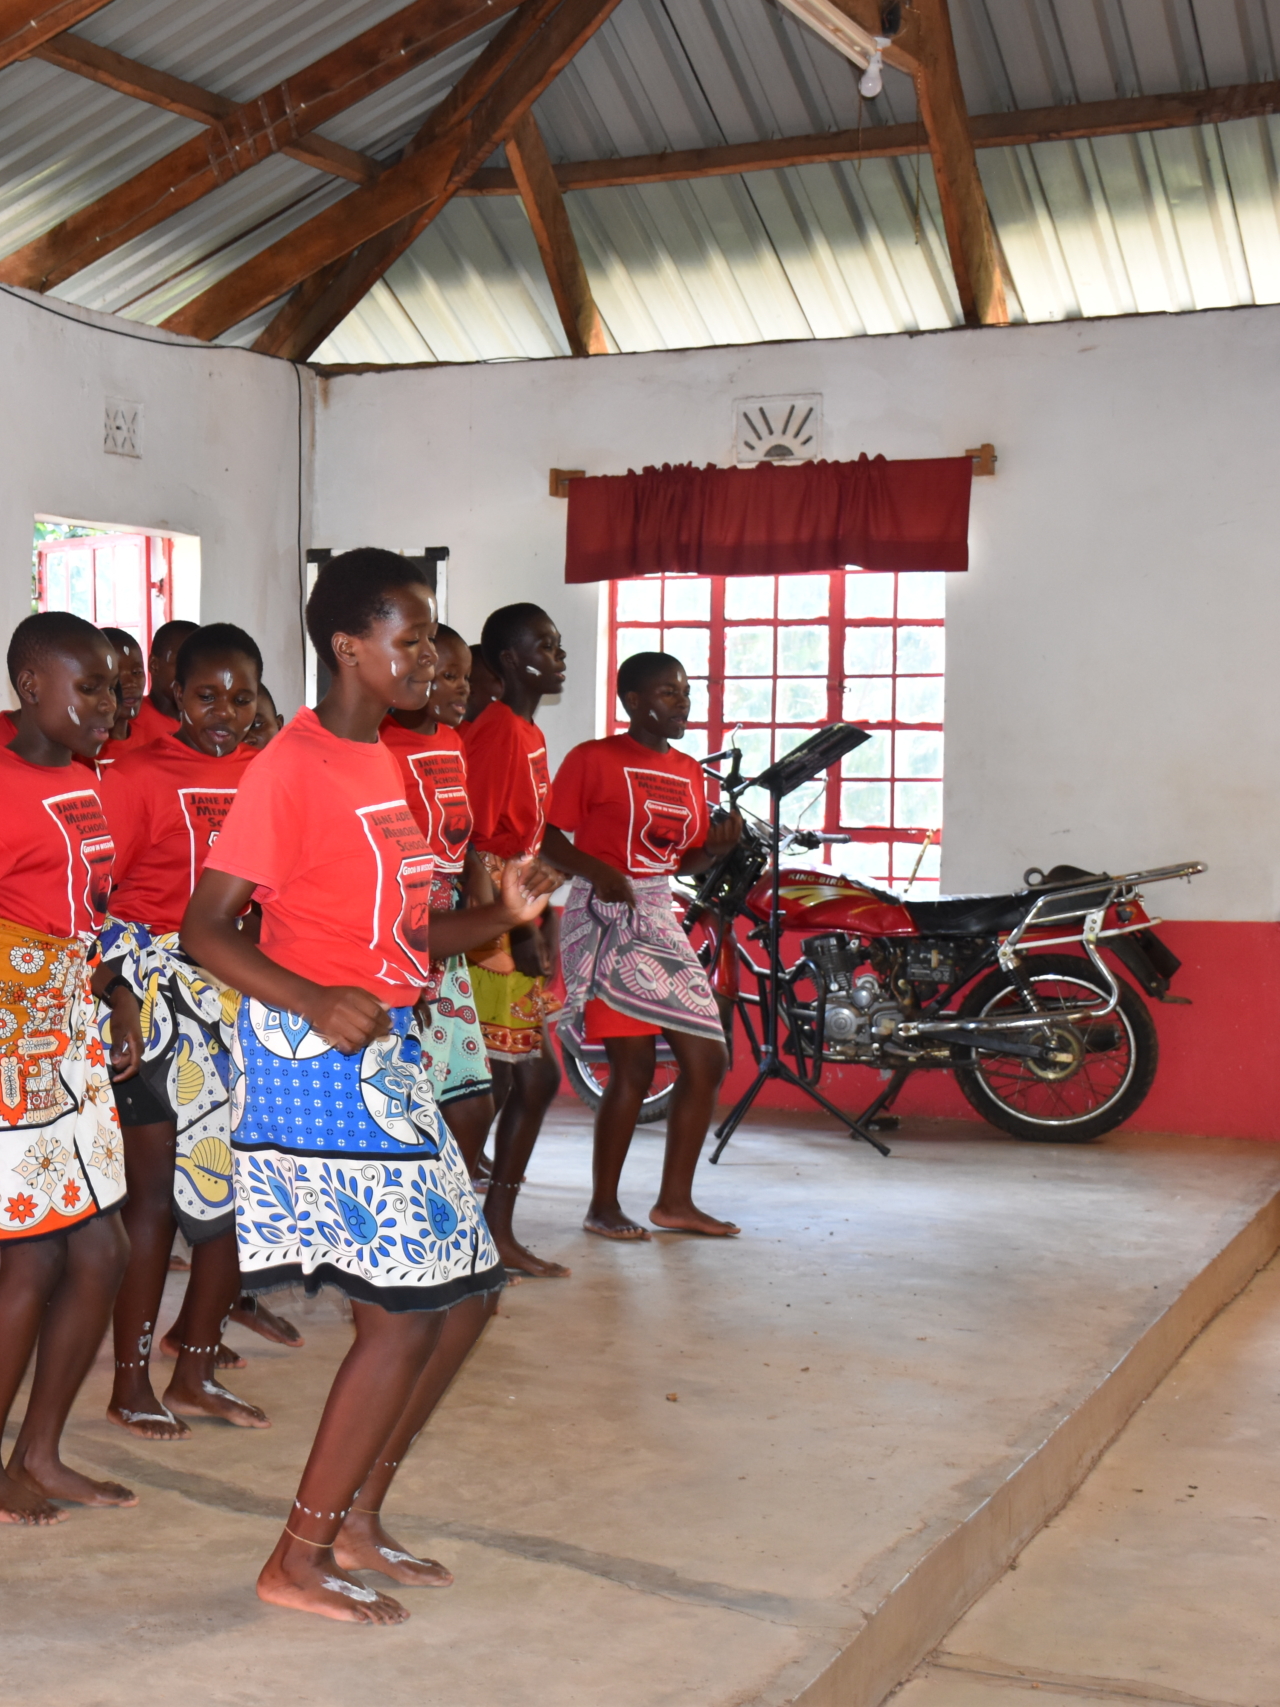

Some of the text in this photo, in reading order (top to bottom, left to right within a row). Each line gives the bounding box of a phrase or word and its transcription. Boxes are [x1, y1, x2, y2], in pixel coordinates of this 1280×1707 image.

[433, 775, 461, 785] SCHOOL
[638, 781, 687, 797] MEMORIAL
[189, 794, 219, 805] JANE
[646, 790, 684, 803] SCHOOL
[55, 801, 79, 814] JANE
[370, 814, 394, 826] JANE
[395, 838, 429, 852] SCHOOL
[402, 866, 417, 875] GROW
[787, 873, 845, 886] KING-BIRD
